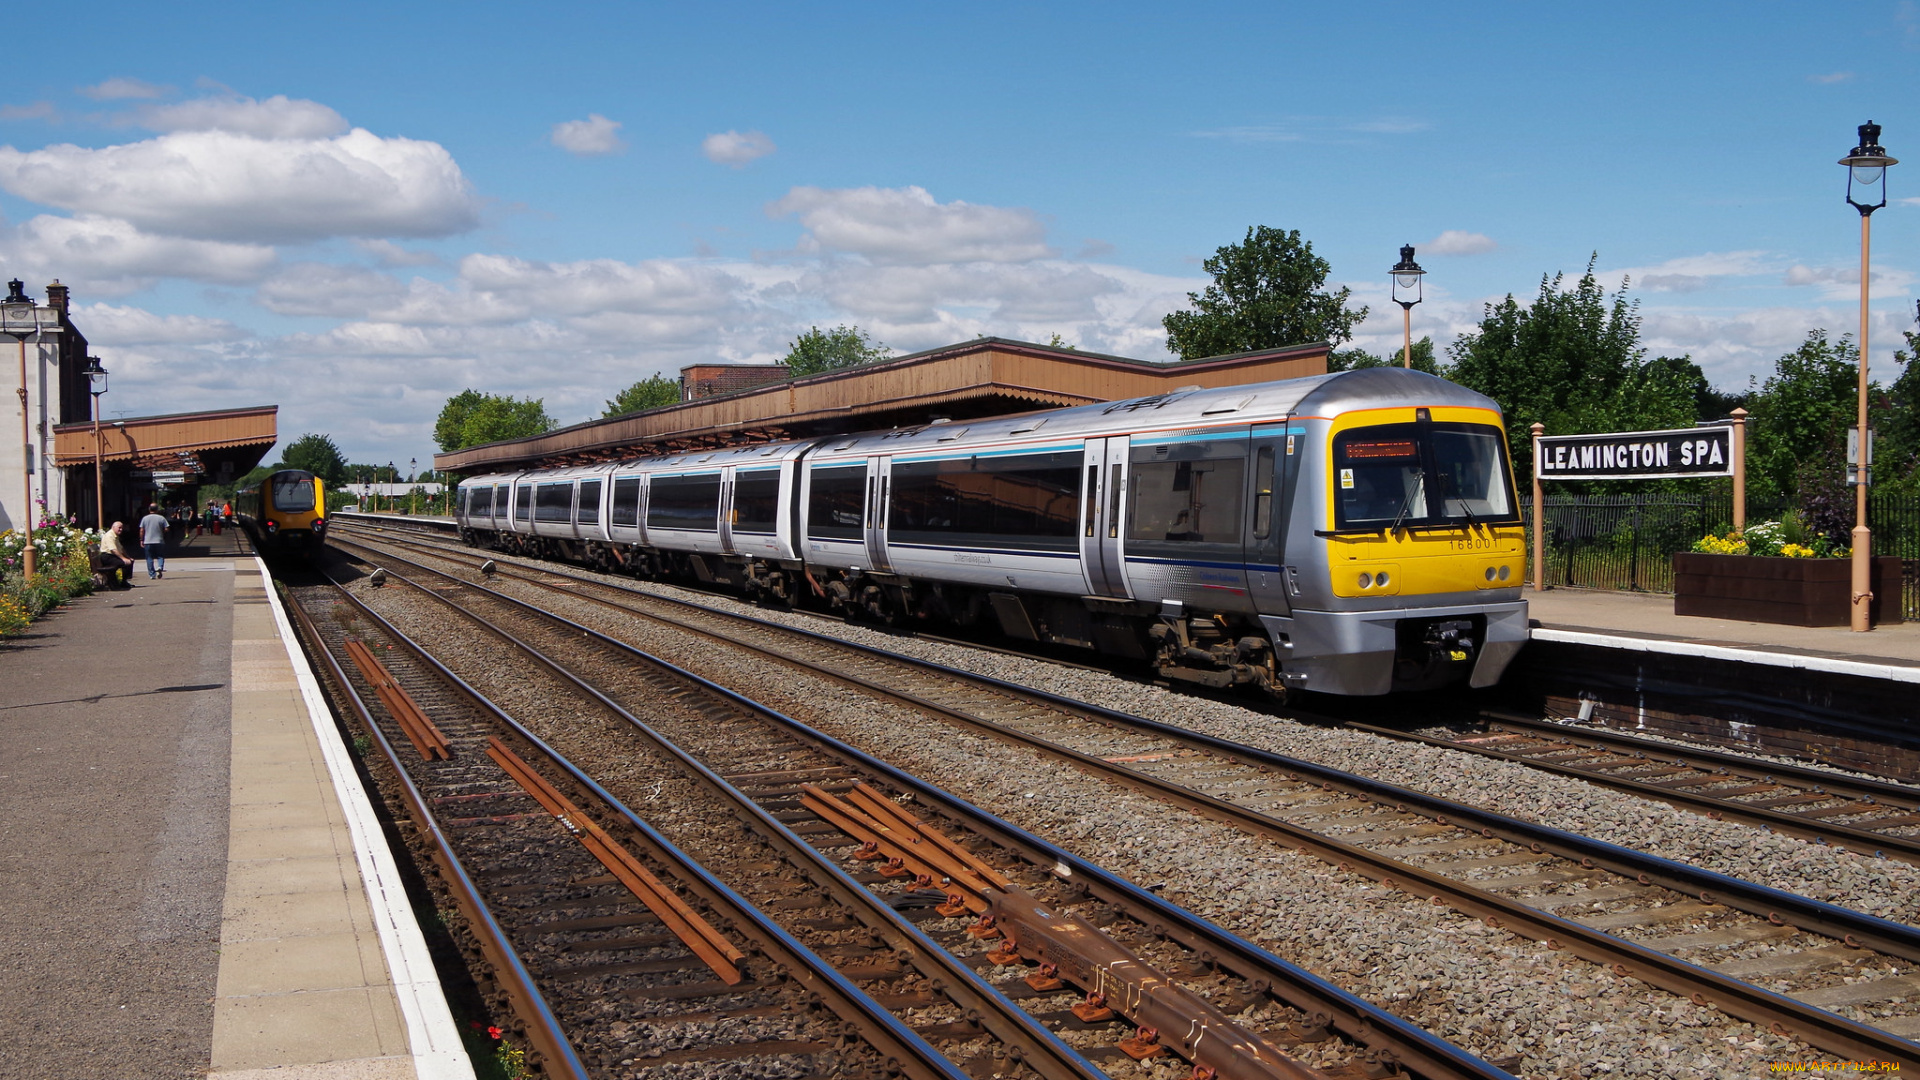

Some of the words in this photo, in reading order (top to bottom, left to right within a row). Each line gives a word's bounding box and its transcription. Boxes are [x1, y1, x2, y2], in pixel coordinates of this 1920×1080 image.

[1544, 441, 1669, 470] LEAMINGTON
[1680, 439, 1723, 466] SPA
[1449, 538, 1498, 550] 168001
